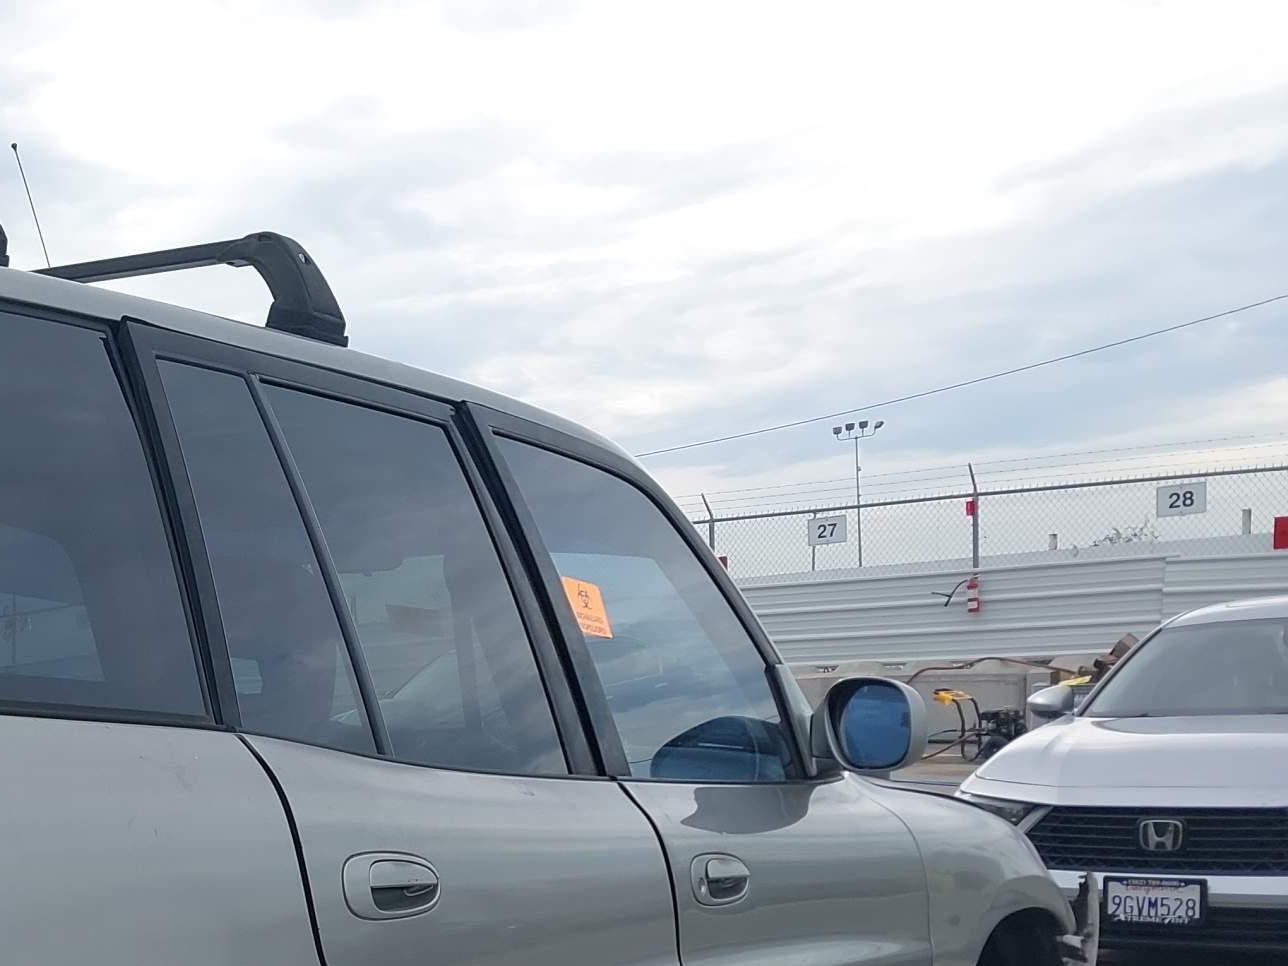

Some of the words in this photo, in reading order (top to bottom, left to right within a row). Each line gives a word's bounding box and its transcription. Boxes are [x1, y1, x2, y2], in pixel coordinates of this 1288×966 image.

[1168, 490, 1194, 509] 28
[817, 522, 837, 538] 27
[1112, 895, 1196, 919] 9GVM528
